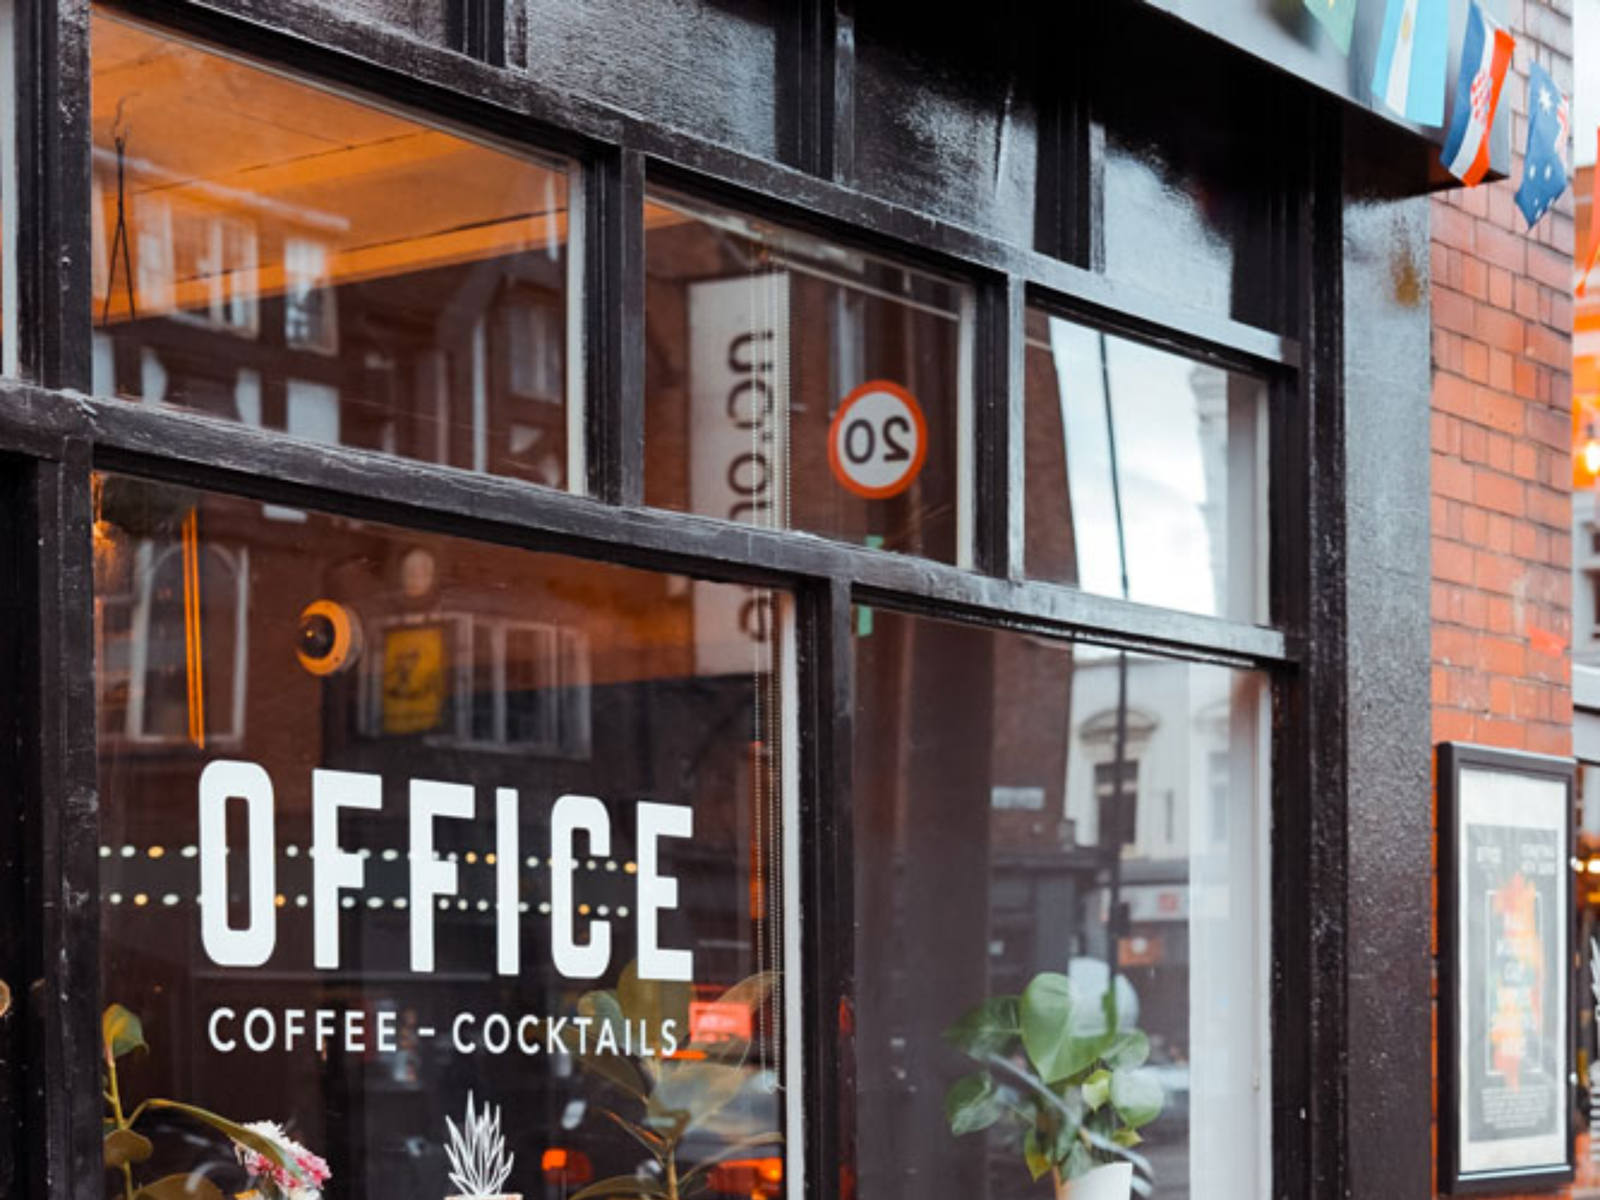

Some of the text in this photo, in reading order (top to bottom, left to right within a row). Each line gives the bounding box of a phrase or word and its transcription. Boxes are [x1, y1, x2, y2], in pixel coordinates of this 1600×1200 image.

[198, 759, 694, 981] OFFICE
[208, 1007, 398, 1053] COFFEE
[452, 1013, 678, 1057] COCKTAILS
